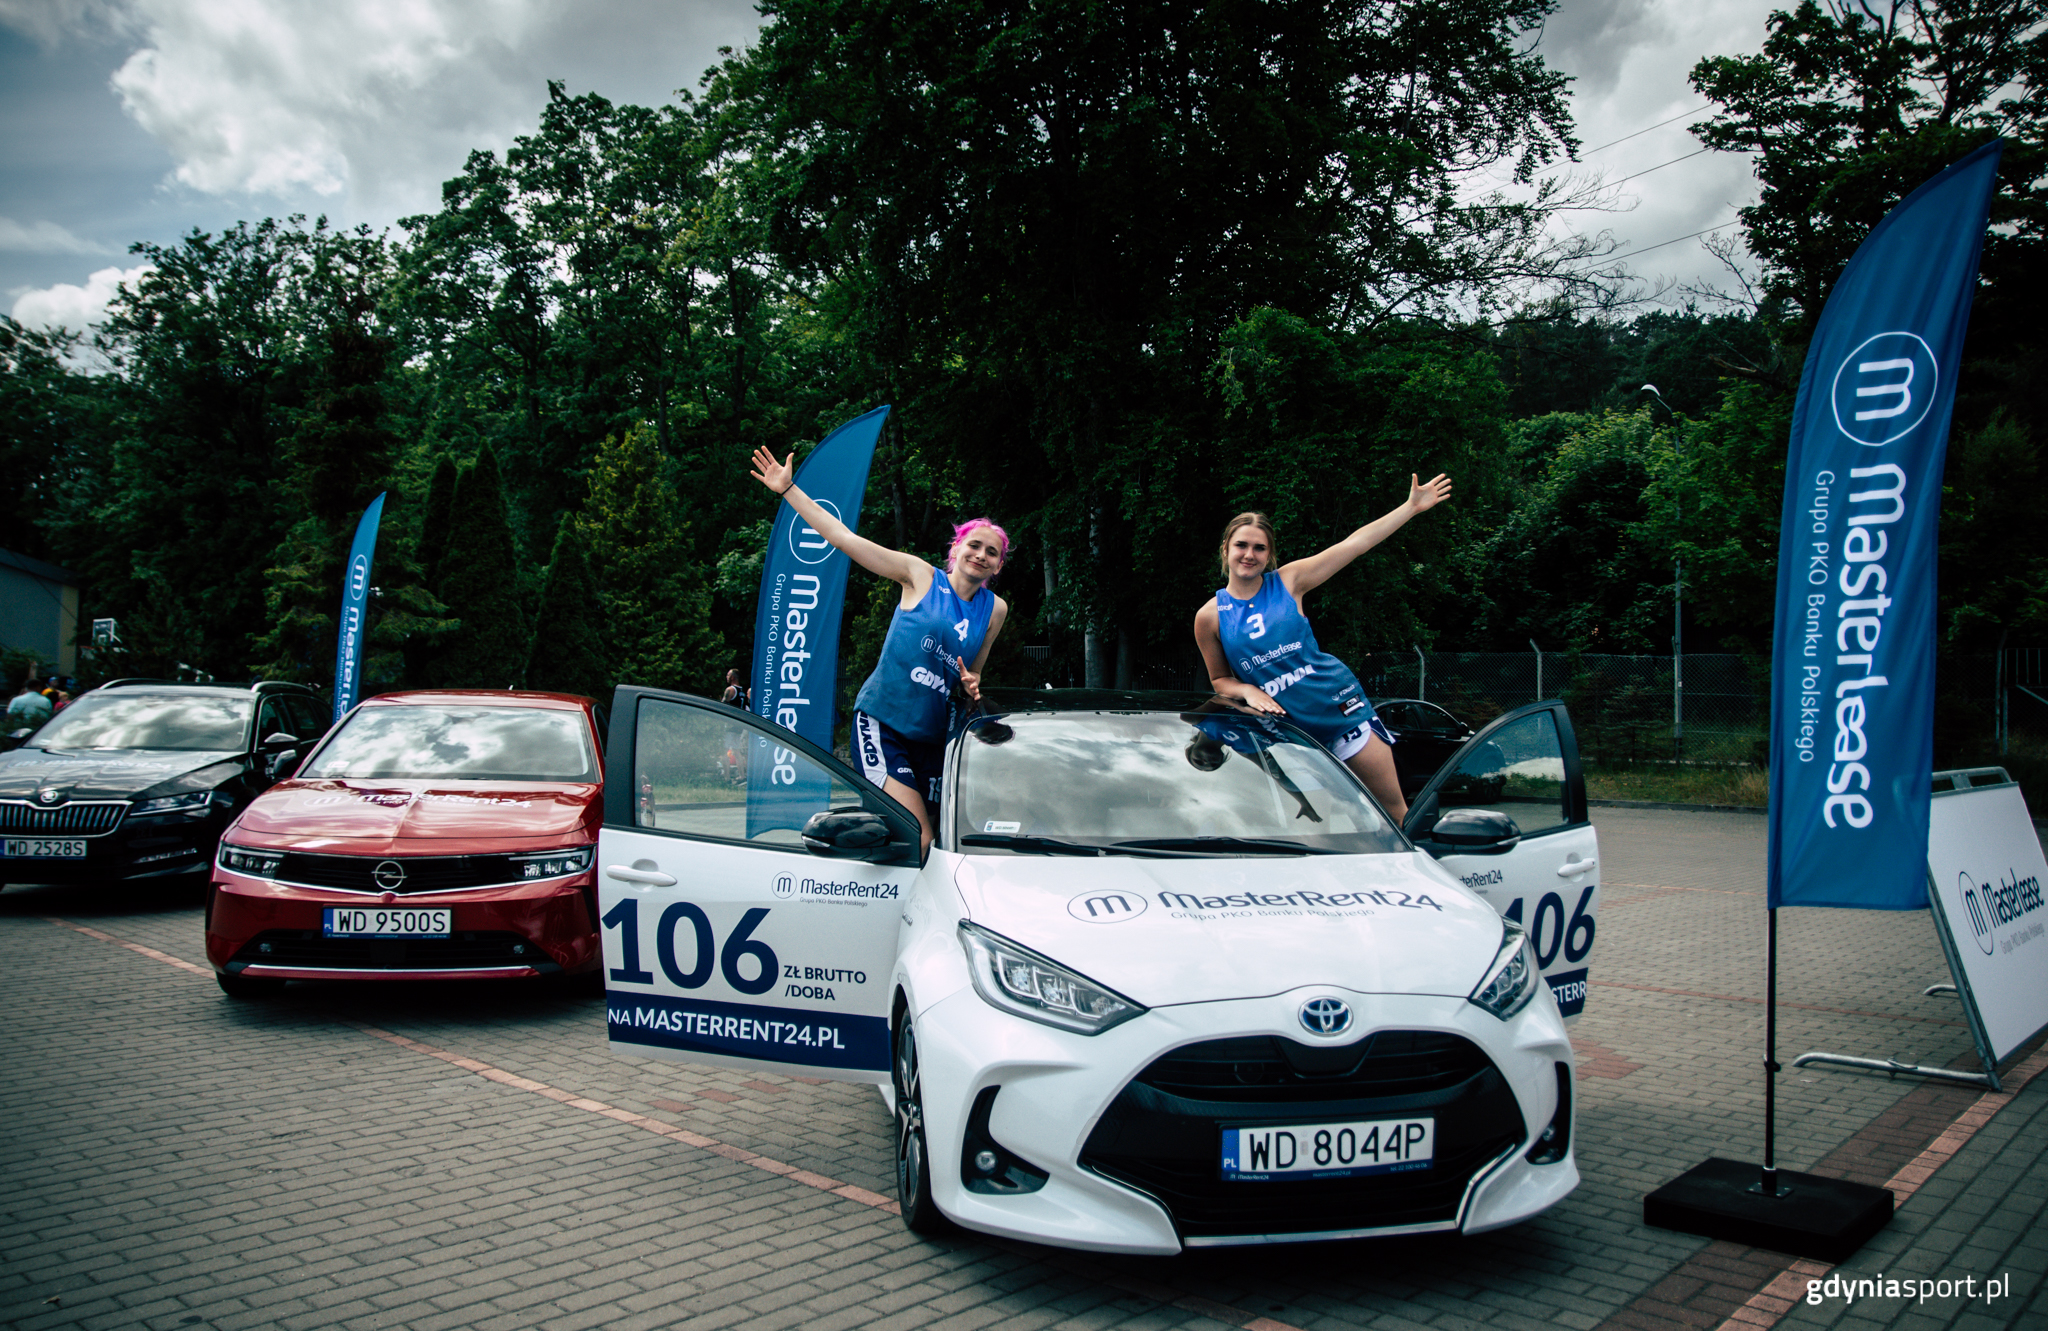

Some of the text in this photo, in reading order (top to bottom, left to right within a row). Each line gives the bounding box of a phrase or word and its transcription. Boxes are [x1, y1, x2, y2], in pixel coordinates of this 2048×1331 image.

[771, 573, 786, 610] Grupa
[768, 615, 780, 641] PKO
[1247, 613, 1266, 639] 3
[1795, 470, 1835, 762] Grupa PKO Banku Polskiego
[954, 618, 969, 641] 4
[764, 646, 776, 684] Banku
[771, 574, 821, 785] Masterlese
[7, 841, 83, 855] WD 2528S
[800, 878, 899, 900] MasterRent24
[1157, 890, 1444, 912] MasterRent24
[1982, 867, 2044, 928] Masterlease
[339, 911, 367, 931] WD
[376, 911, 446, 932] 9500S
[1171, 909, 1375, 921] Grupa PKO Banku Polskiego
[601, 897, 779, 995] 106
[784, 965, 866, 984] ZŁ BRUTTO
[785, 984, 835, 1000] /DOBA
[608, 1006, 845, 1049] NA MASTERRENT24.PL
[1223, 1123, 1425, 1171] PL WD 8044P
